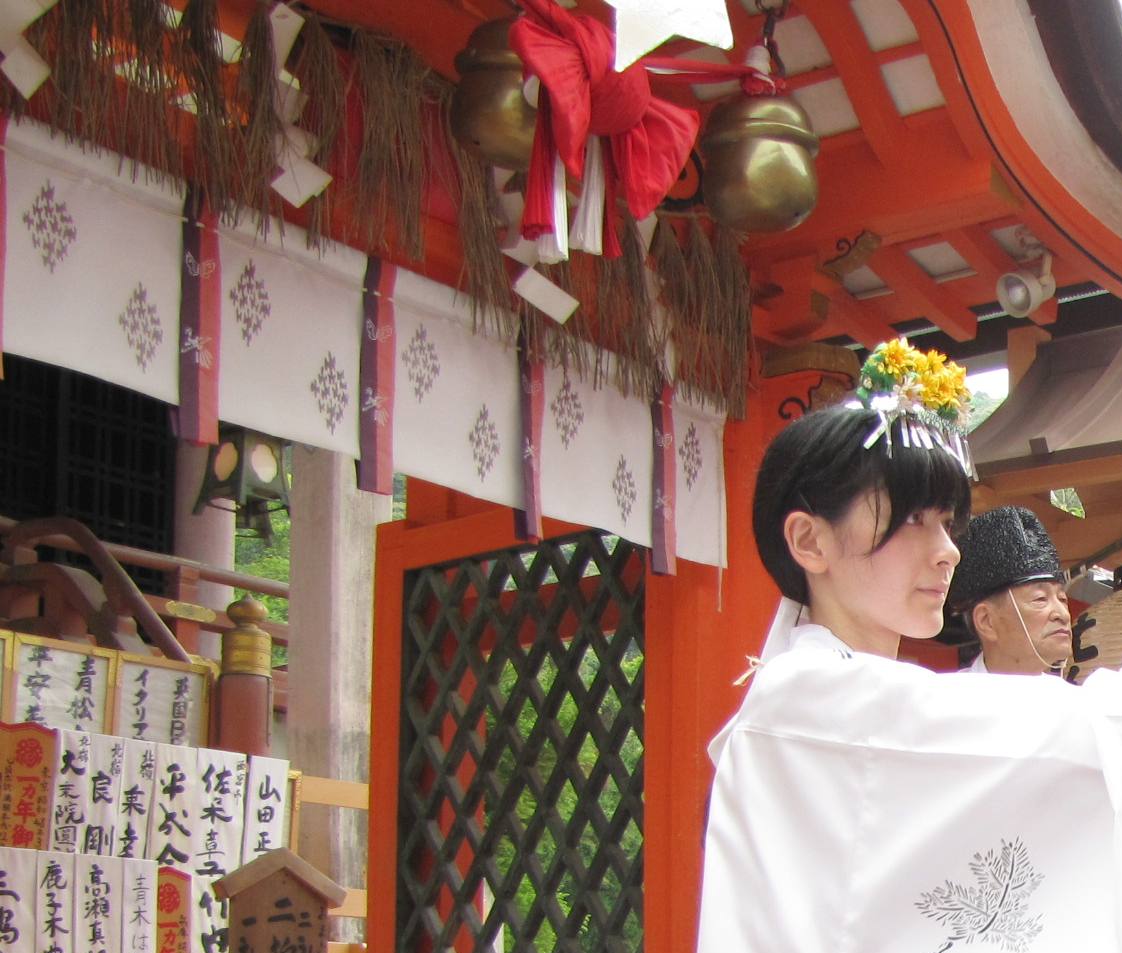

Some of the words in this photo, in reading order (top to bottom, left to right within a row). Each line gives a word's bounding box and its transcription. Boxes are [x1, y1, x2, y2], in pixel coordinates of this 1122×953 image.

[66, 655, 96, 731] 青松
[132, 668, 149, 740] イタリア
